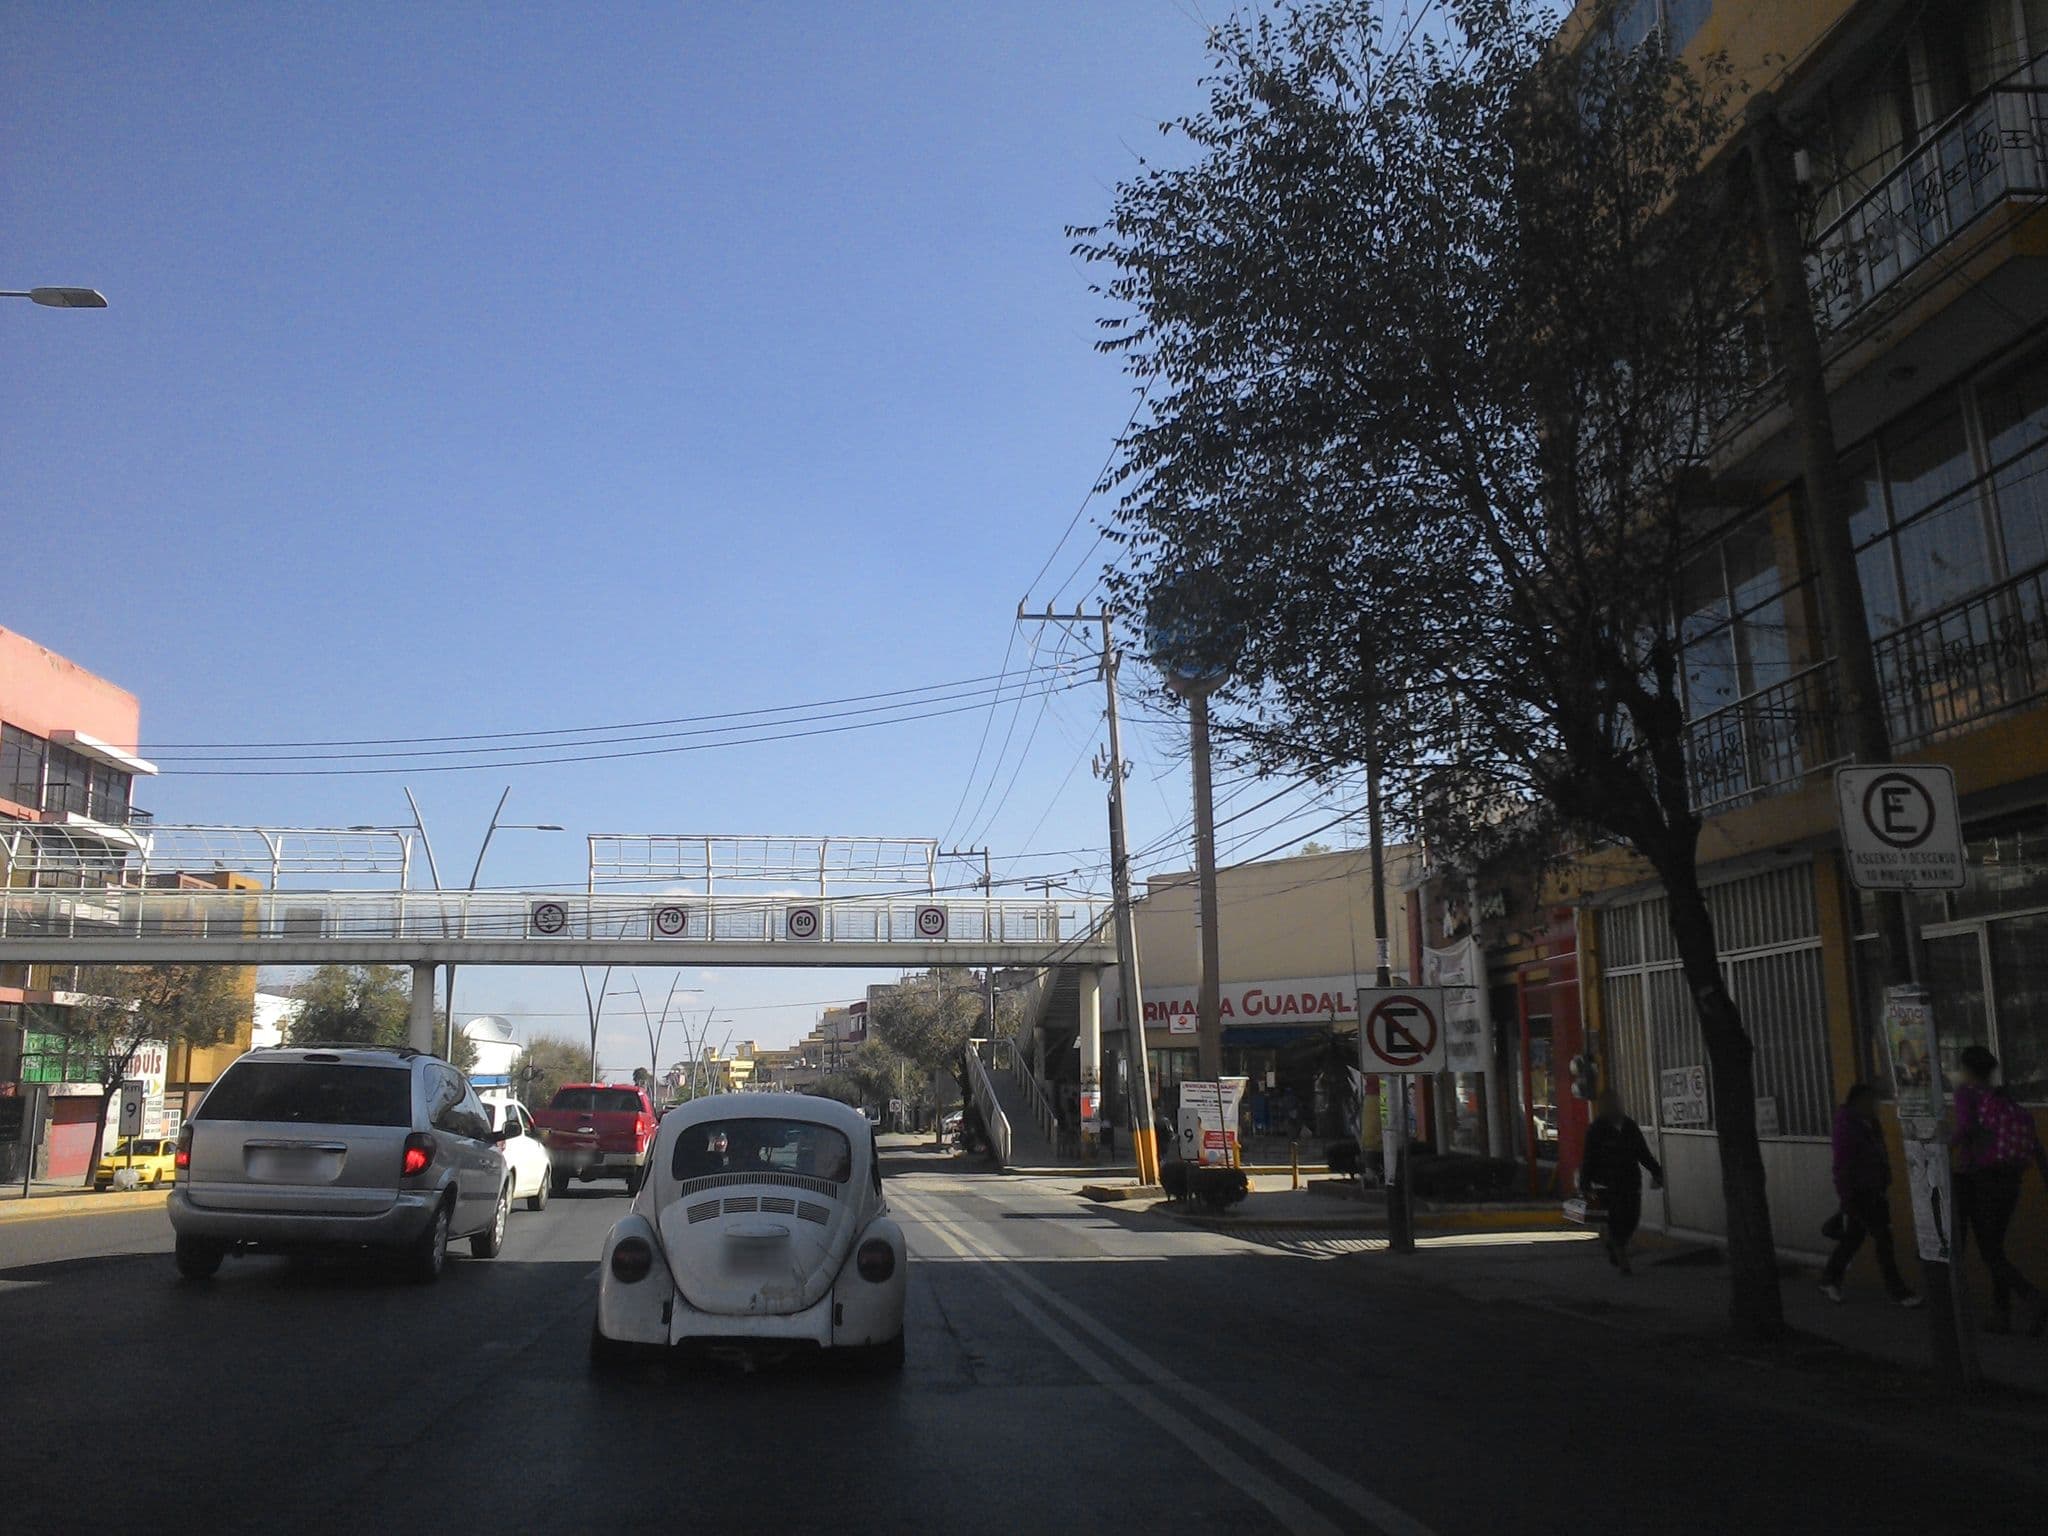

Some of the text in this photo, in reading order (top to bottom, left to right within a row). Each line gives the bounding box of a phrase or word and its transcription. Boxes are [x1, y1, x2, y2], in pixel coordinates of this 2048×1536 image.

[1881, 787, 1917, 833] E
[664, 912, 679, 923] 70
[796, 915, 811, 927] 60
[924, 914, 939, 925] 50
[124, 1082, 140, 1092] km
[126, 1102, 137, 1118] 9
[1183, 1128, 1194, 1142] 9
